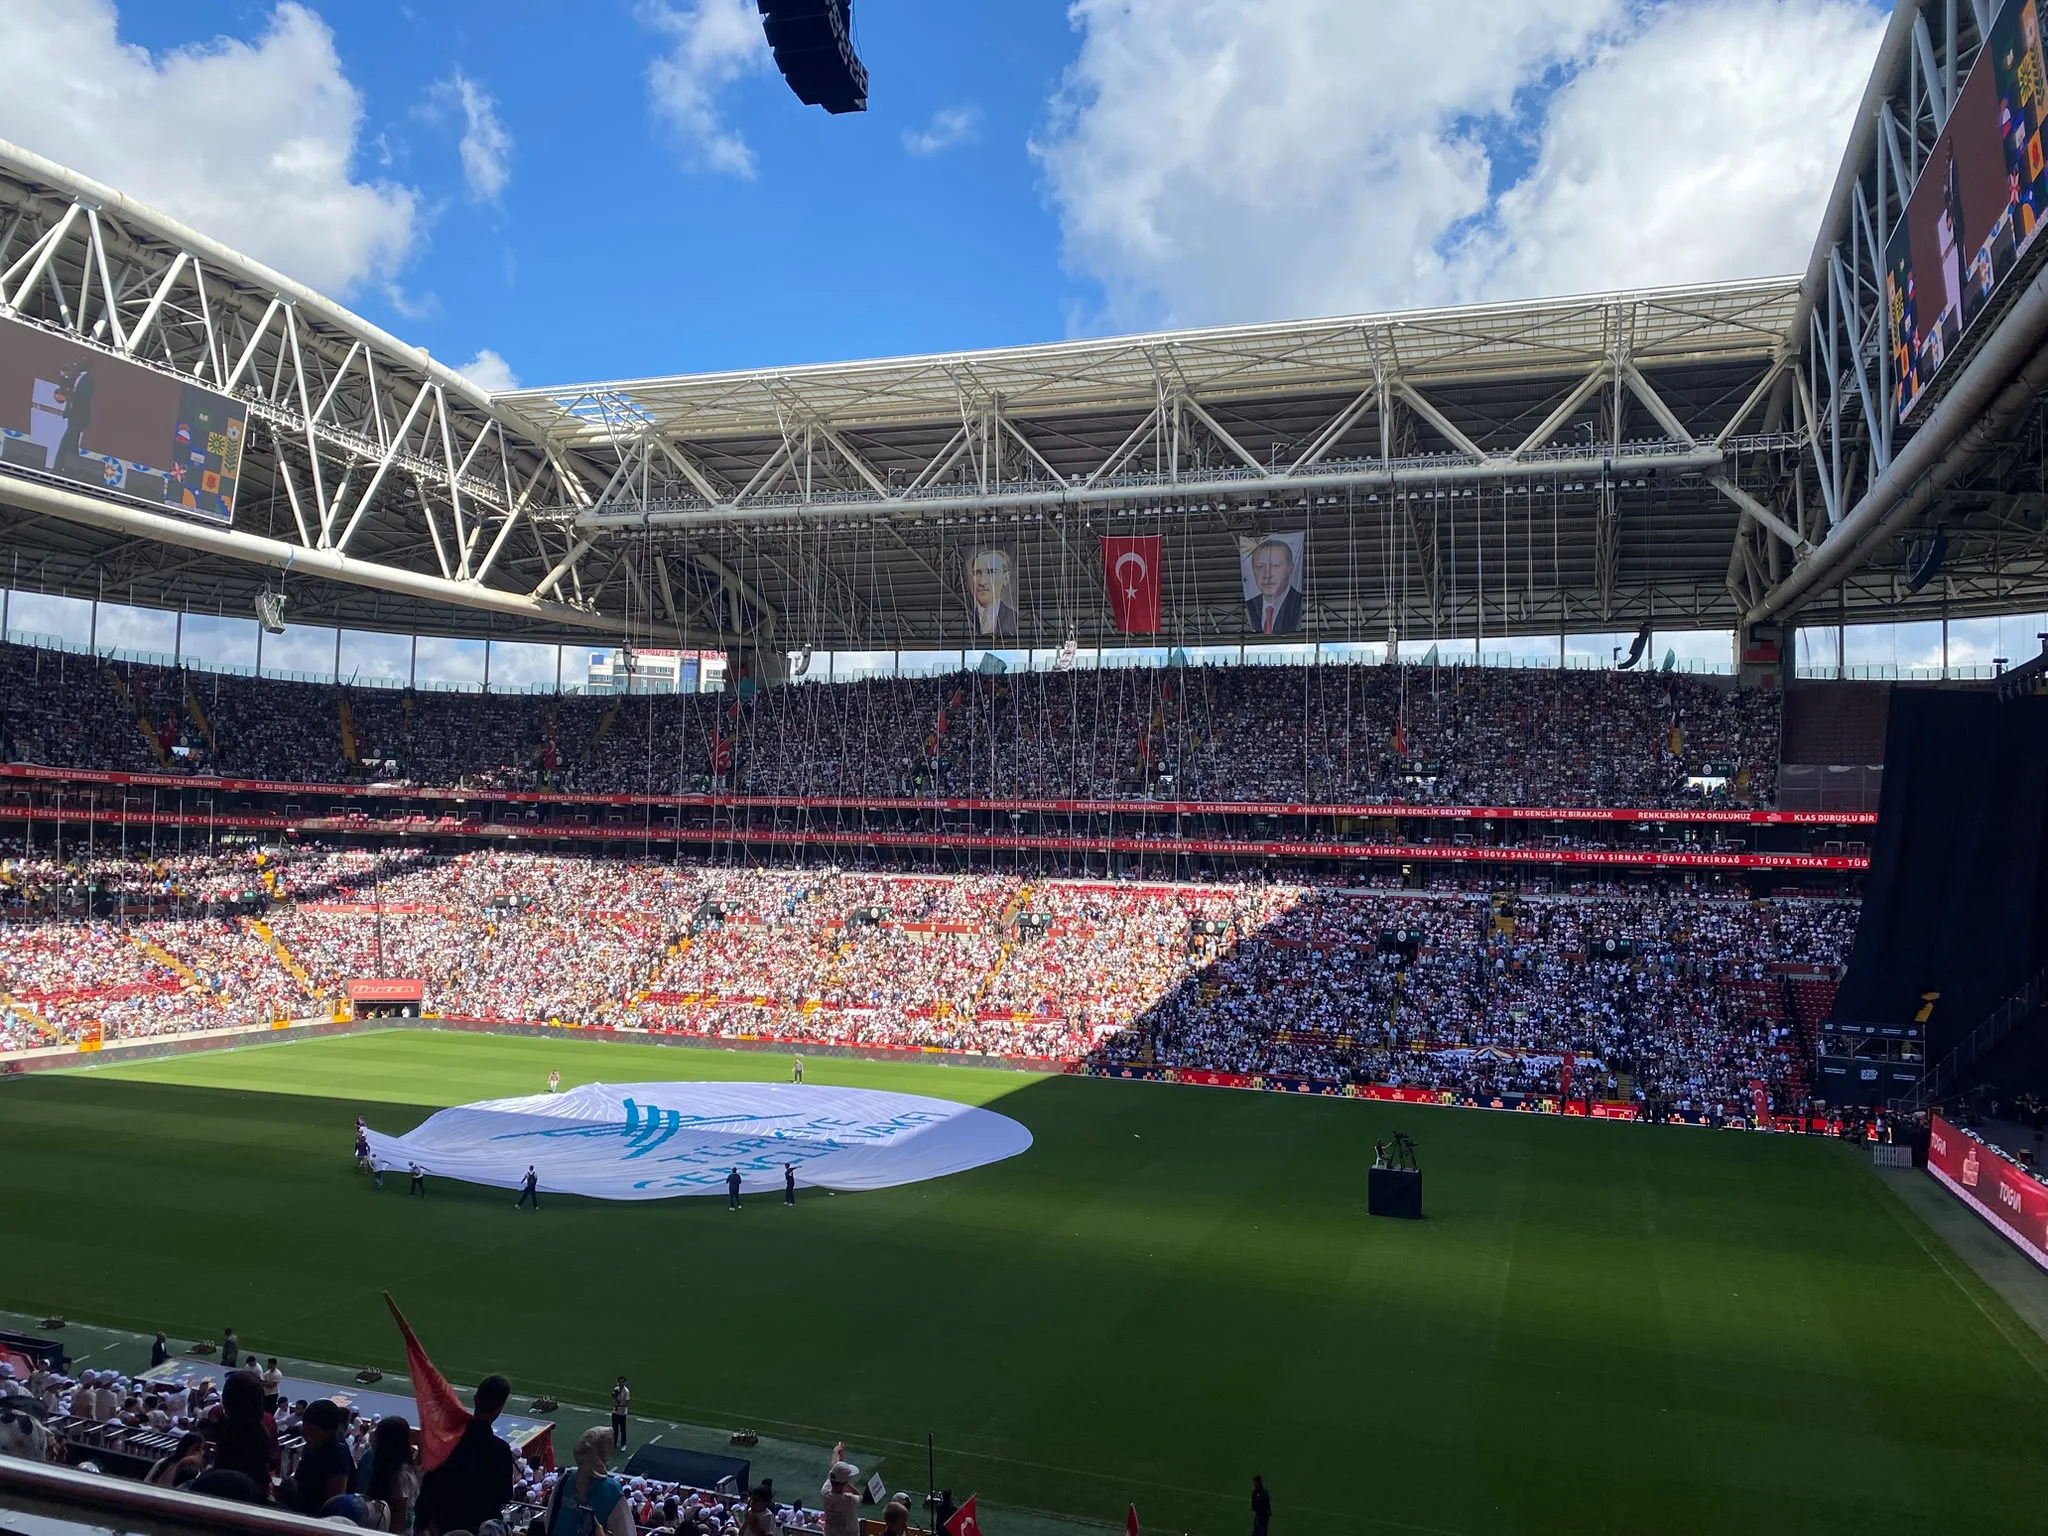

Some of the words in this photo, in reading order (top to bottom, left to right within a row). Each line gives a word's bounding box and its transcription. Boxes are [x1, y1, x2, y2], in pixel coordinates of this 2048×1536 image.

[36, 769, 64, 778] GENÇLİK
[130, 775, 172, 784] RENKLENSİN
[318, 785, 346, 794] GENÇLİK
[1260, 805, 1289, 814] GENÇLİK
[1407, 807, 1439, 816] GENÇLİK
[1525, 809, 1558, 818] GENÇLİK
[1638, 811, 1689, 819] RENKLENSİN
[1280, 845, 1306, 853] TÜGVA
[1375, 847, 1401, 855] SİNOP
[1410, 848, 1438, 856] TÜGVA
[1442, 849, 1468, 857] SİVAS
[1478, 850, 1507, 858] TÜGVA
[1510, 852, 1563, 860] ŞANLIURFA
[1575, 852, 1605, 861] TÜGVA
[1608, 854, 1644, 863] ŞIRNAK
[1691, 856, 1740, 864] TEKİRDAĞ
[1759, 857, 1791, 865] TÜGVA
[1848, 860, 1869, 868] TÜG
[839, 1111, 950, 1138] VAKFI
